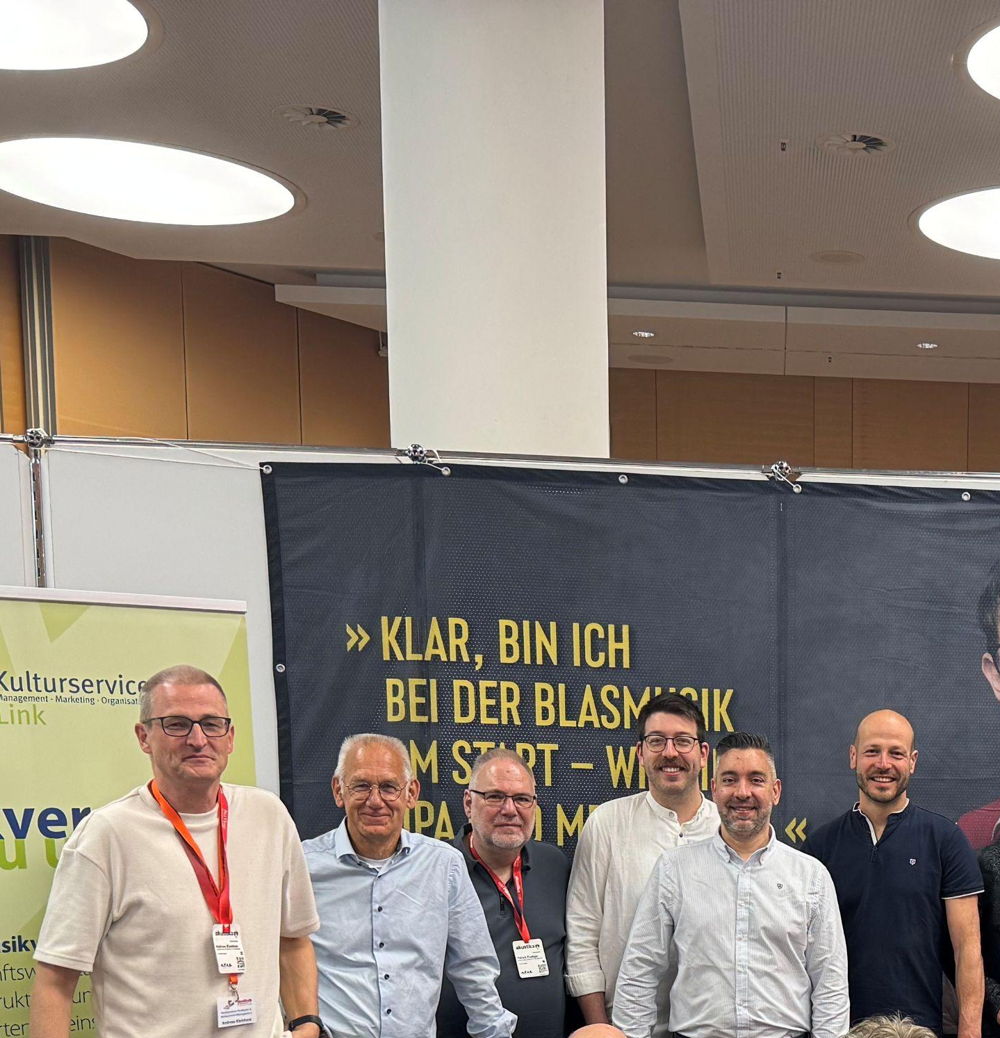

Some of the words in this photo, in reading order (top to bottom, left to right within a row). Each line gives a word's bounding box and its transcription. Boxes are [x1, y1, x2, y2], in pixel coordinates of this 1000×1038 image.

[381, 616, 484, 671] KLAR,
[499, 620, 558, 666] BIN
[573, 622, 631, 668] ICH
[0, 694, 48, 703] anagement
[55, 695, 95, 705] Marketing
[0, 703, 47, 725] Link
[386, 678, 438, 723] BEI
[453, 680, 522, 726] DER
[535, 683, 735, 732] BLASMIK
[452, 740, 559, 787] SRT
[0, 807, 92, 840] ver
